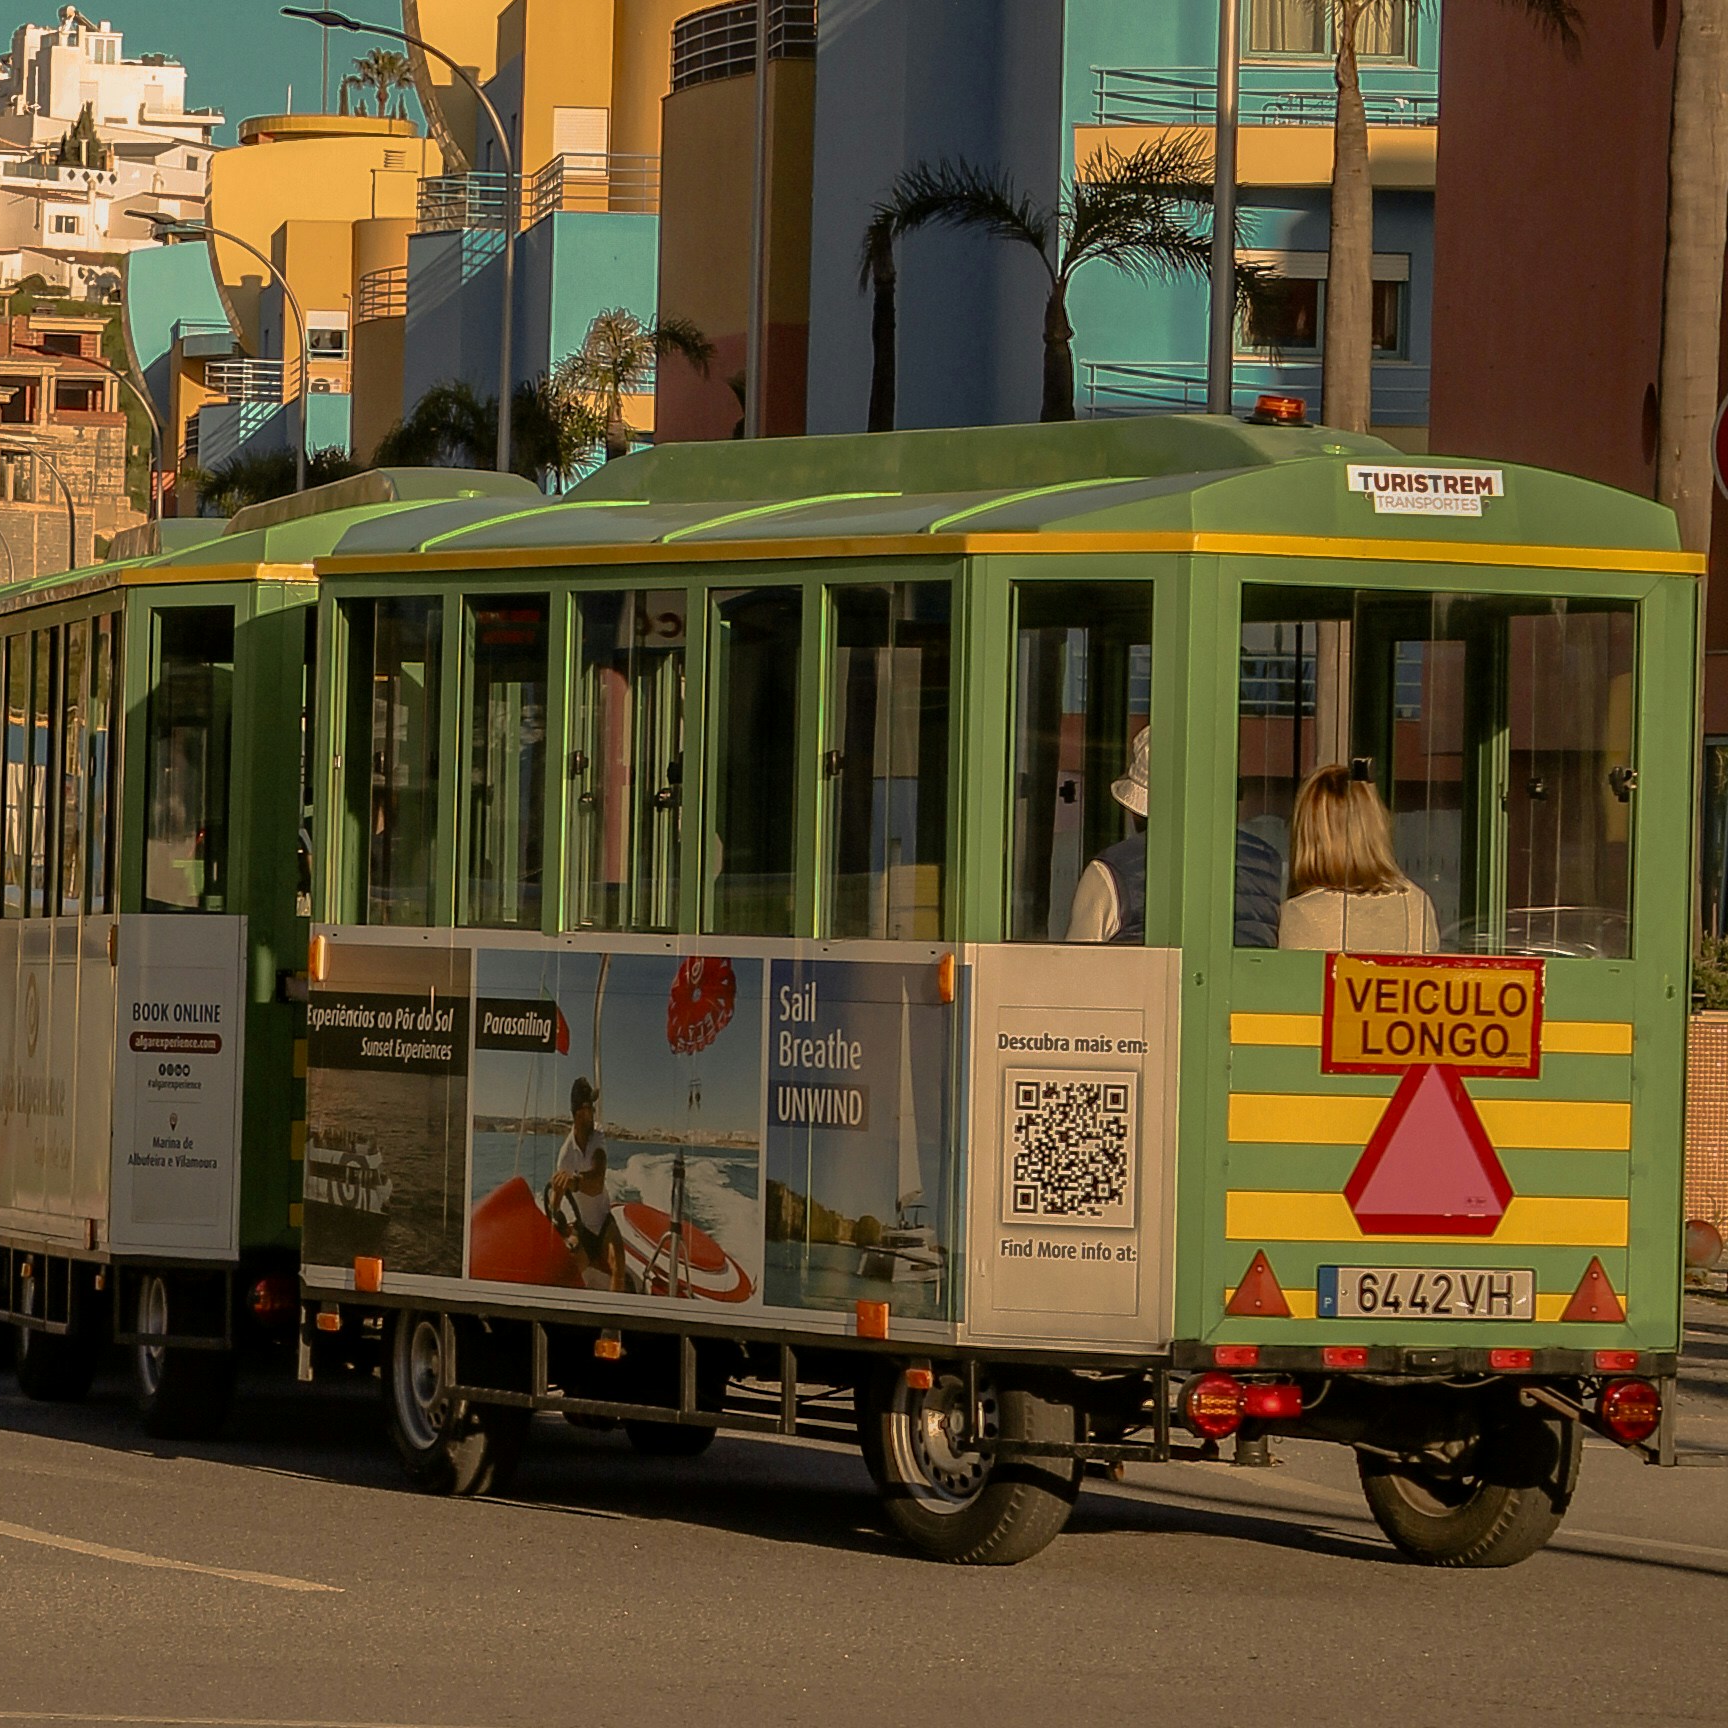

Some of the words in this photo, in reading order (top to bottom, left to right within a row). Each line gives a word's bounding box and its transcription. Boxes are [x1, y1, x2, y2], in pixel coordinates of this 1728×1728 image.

[1358, 472, 1493, 495] TURISTREM
[1376, 495, 1479, 511] TRANSPORTES
[779, 981, 816, 1022] Sail
[1345, 977, 1527, 1017] VEICULO
[132, 1002, 169, 1021] BOOK
[173, 1004, 221, 1023] ONLINE
[307, 1003, 375, 1031] Experiências
[378, 1012, 392, 1028] ao
[395, 1007, 415, 1030] Pôr
[417, 1006, 432, 1031] do
[434, 1008, 454, 1032] Sol
[483, 1012, 552, 1043] Parasailing
[1362, 1020, 1508, 1058] LONGO
[135, 1035, 216, 1050] algarexperience.com
[361, 1037, 394, 1057] Sunset
[395, 1039, 452, 1063] Experiences
[779, 1029, 862, 1070] Breathe
[998, 1033, 1069, 1051] Descubra
[1074, 1035, 1112, 1053] mais
[1117, 1040, 1148, 1054] em:
[778, 1086, 863, 1125] UNWIND
[153, 1137, 180, 1149] Marina
[183, 1137, 193, 1149] de
[128, 1152, 165, 1166] Albufeira
[168, 1158, 173, 1166] e
[175, 1155, 217, 1168] Vilamoura
[1001, 1239, 1033, 1257] Find
[1037, 1241, 1077, 1259] More
[1081, 1242, 1112, 1260] info
[1116, 1245, 1137, 1262] at:
